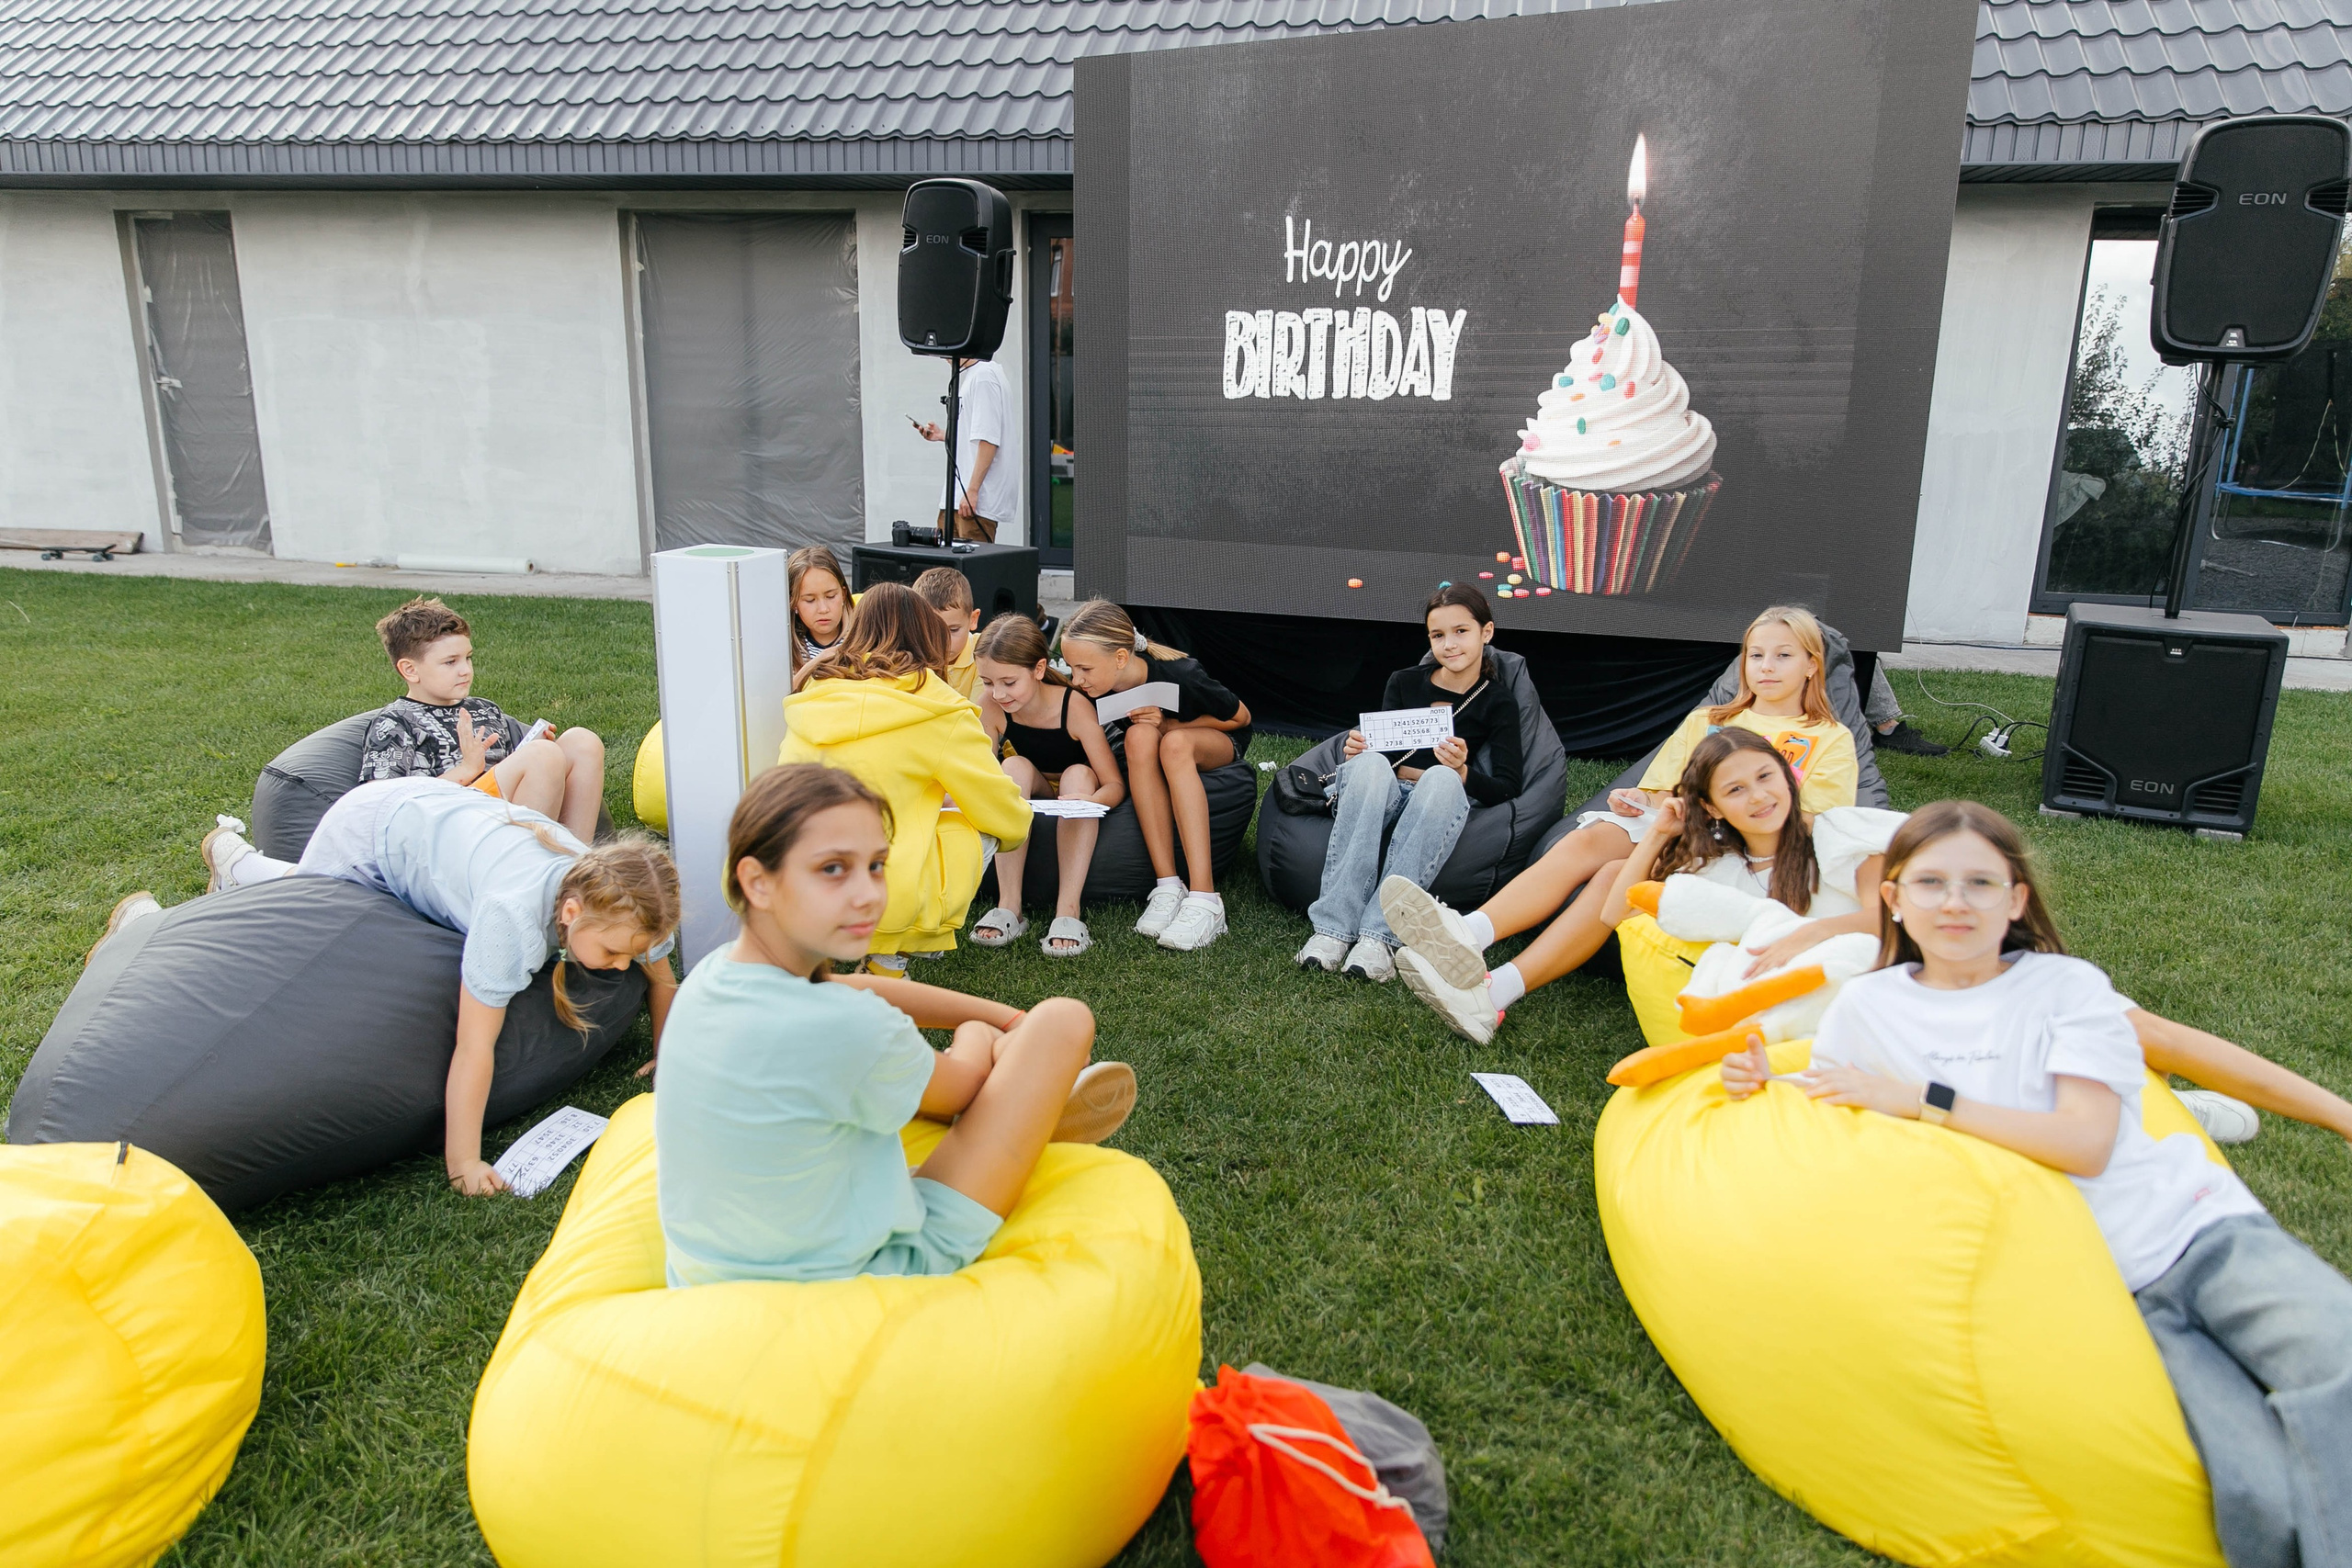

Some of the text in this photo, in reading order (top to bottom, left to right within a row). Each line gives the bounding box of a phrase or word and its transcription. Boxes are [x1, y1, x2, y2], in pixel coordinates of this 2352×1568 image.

[2238, 193, 2287, 205] EON
[926, 234, 949, 244] EON
[1284, 215, 1412, 302] Happy
[1223, 306, 1467, 400] BIRTHDAY
[2130, 779, 2175, 795] EON
